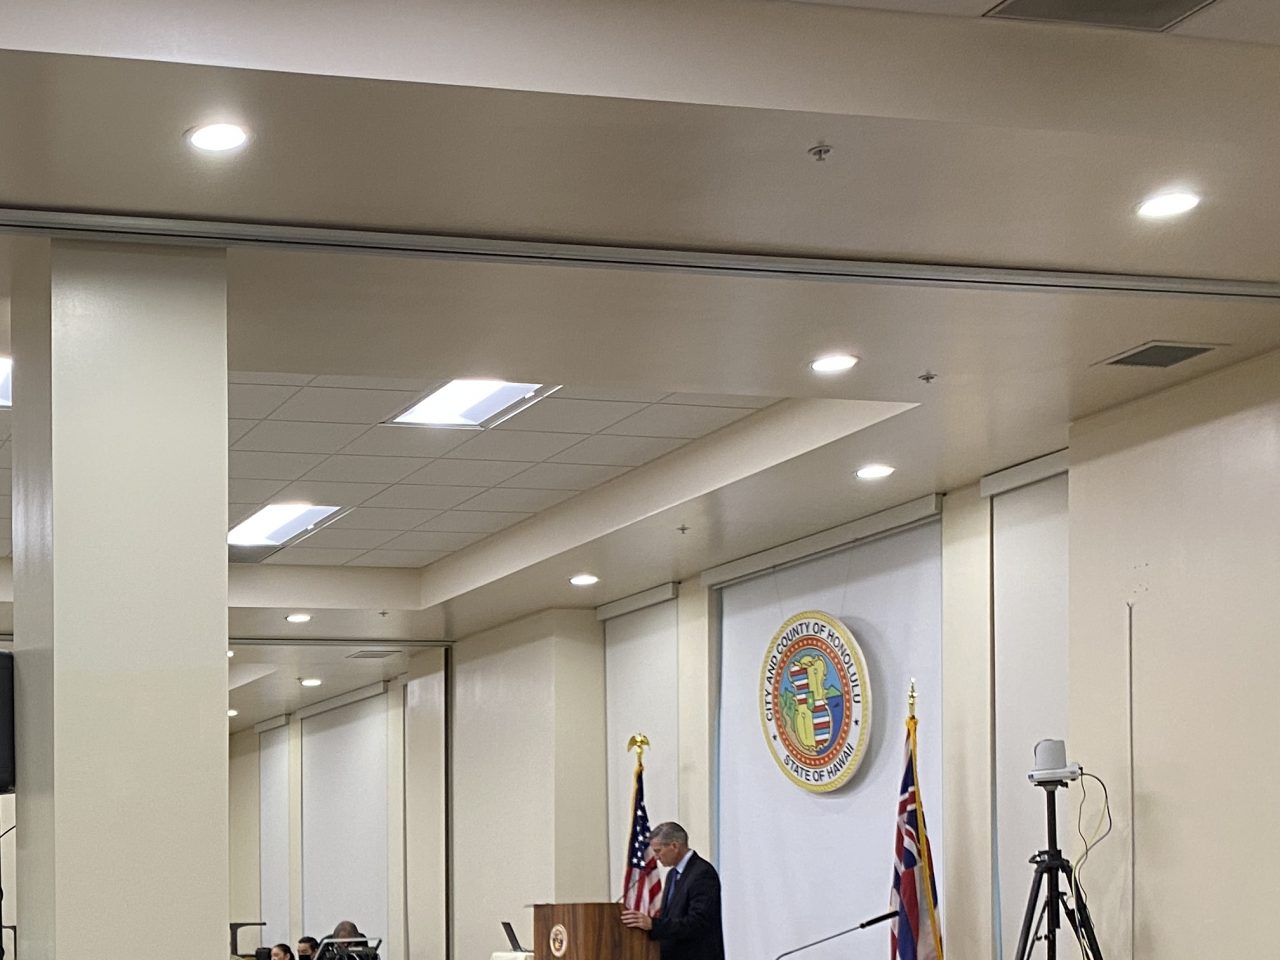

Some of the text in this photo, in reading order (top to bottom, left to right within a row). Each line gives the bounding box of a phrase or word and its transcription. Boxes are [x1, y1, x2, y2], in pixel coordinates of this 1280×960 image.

[765, 622, 861, 722] CITY AND COUNTY OF HONOLULU
[783, 743, 854, 782] STATE OF HAWAII
